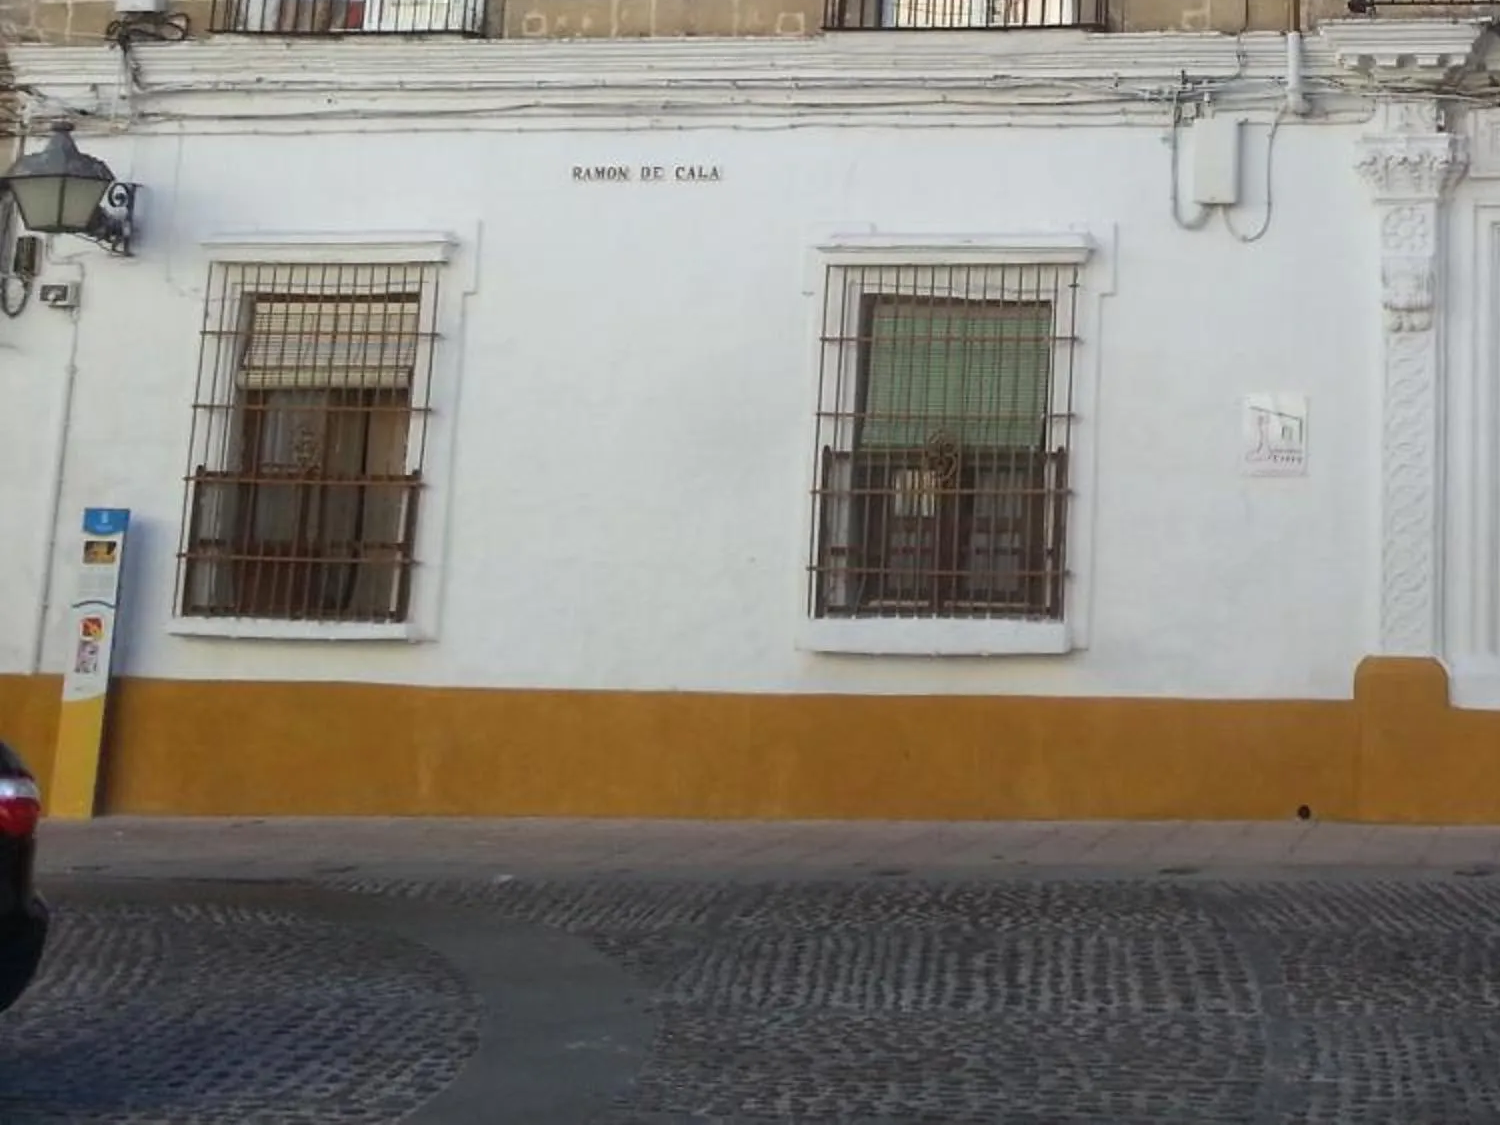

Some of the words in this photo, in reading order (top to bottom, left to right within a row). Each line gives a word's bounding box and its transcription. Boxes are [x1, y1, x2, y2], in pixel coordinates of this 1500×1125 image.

[572, 166, 630, 181] RAMON
[640, 166, 664, 181] DE
[674, 166, 721, 181] CALA
